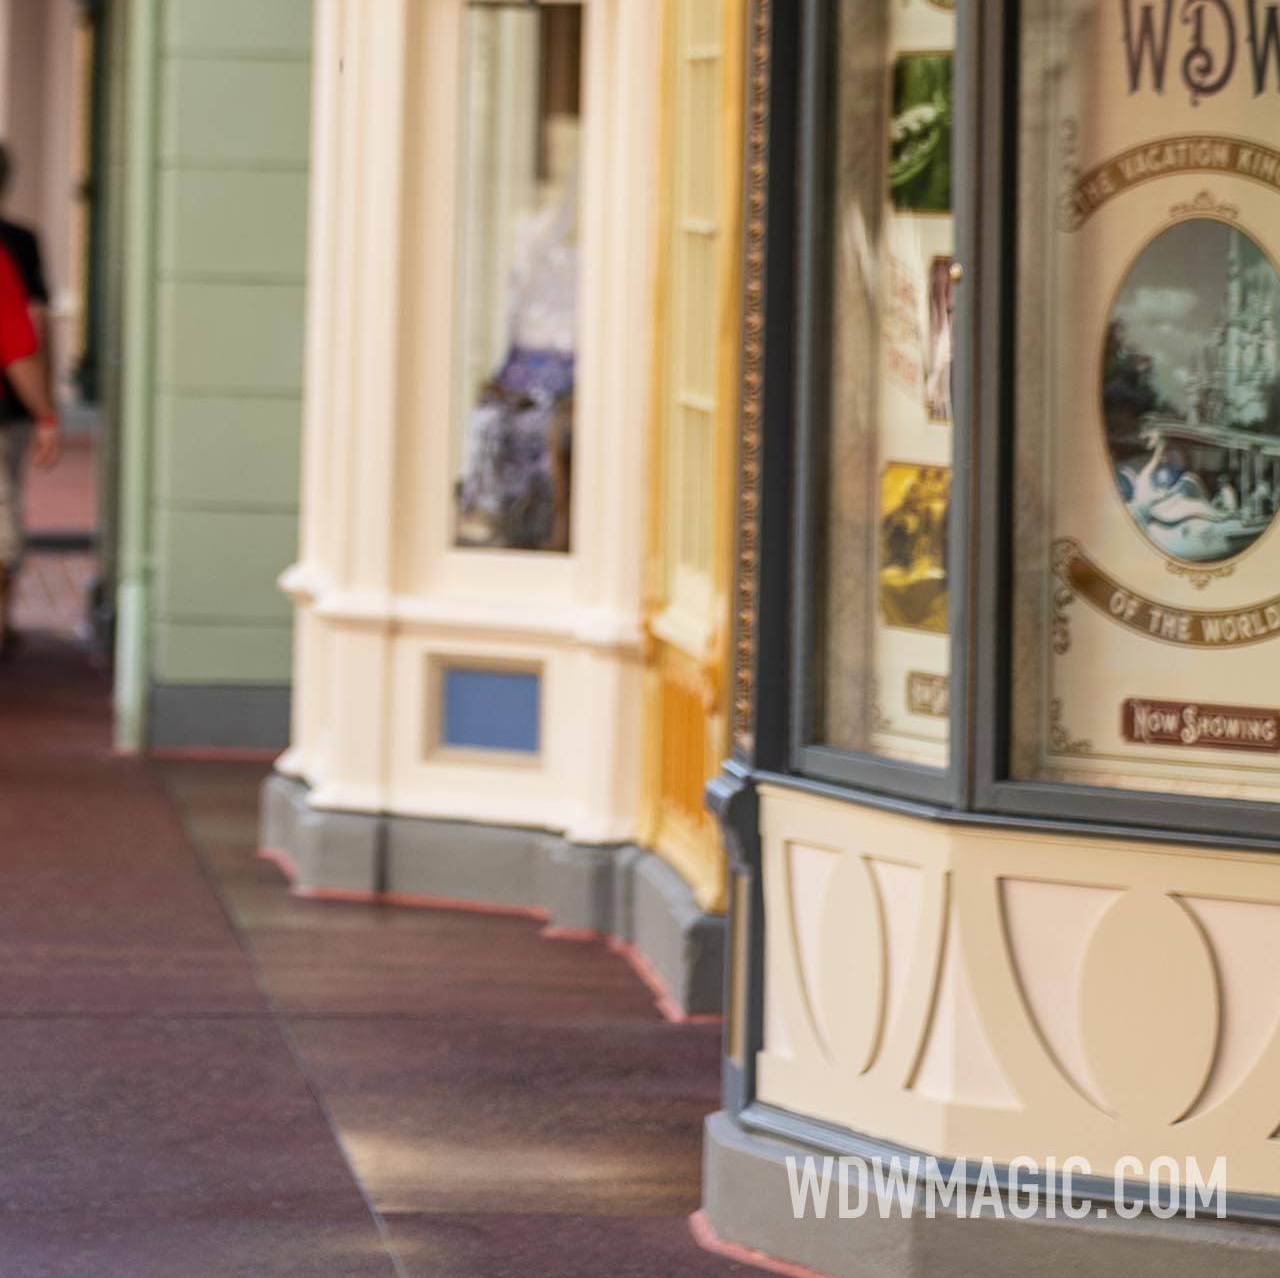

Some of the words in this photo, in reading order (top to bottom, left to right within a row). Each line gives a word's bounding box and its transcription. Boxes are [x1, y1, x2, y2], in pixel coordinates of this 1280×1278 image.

[1119, 138, 1230, 182] VACATION
[1108, 588, 1141, 621] OF
[1148, 608, 1193, 641] THE
[1200, 607, 1280, 643] WORLD
[1130, 699, 1179, 743] NOW
[1180, 705, 1277, 744] SHOWING
